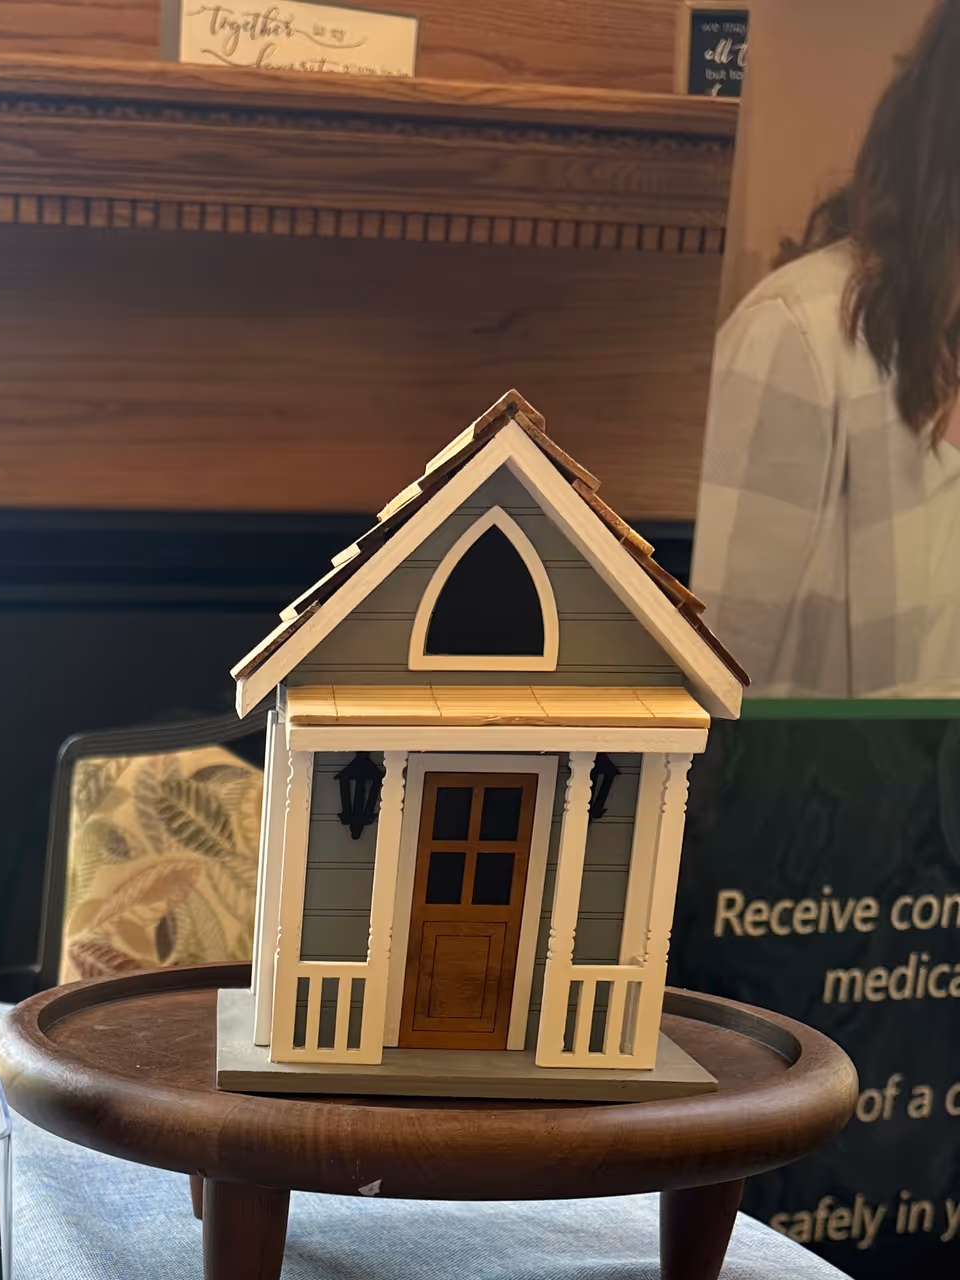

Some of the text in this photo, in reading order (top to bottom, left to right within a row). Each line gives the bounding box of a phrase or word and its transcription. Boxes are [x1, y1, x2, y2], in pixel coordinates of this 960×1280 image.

[713, 884, 881, 938] Receive
[855, 1072, 904, 1123] of
[906, 1084, 933, 1119] a
[768, 1192, 887, 1250] safely
[895, 1189, 934, 1234] in
